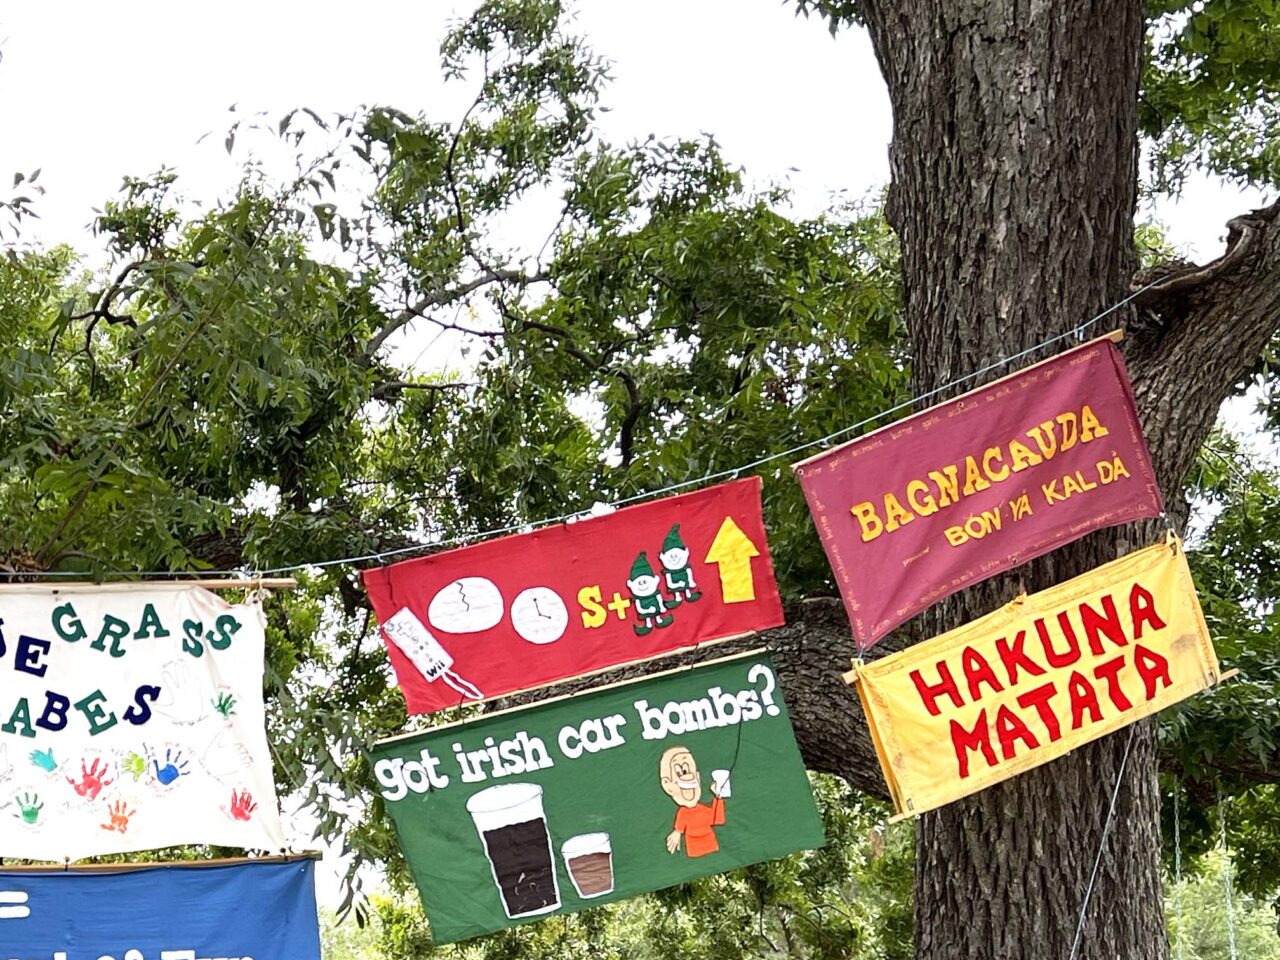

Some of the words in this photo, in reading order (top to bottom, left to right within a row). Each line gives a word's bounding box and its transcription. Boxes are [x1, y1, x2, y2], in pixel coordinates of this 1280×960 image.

[850, 405, 1109, 543] BAGNACAUDA
[426, 660, 447, 678] Wii
[909, 583, 1166, 716] HAKUNA
[949, 643, 1172, 778] MATATA
[374, 754, 449, 801] got
[452, 731, 554, 783] irish
[558, 712, 627, 758] car
[635, 664, 781, 741] bombs?
